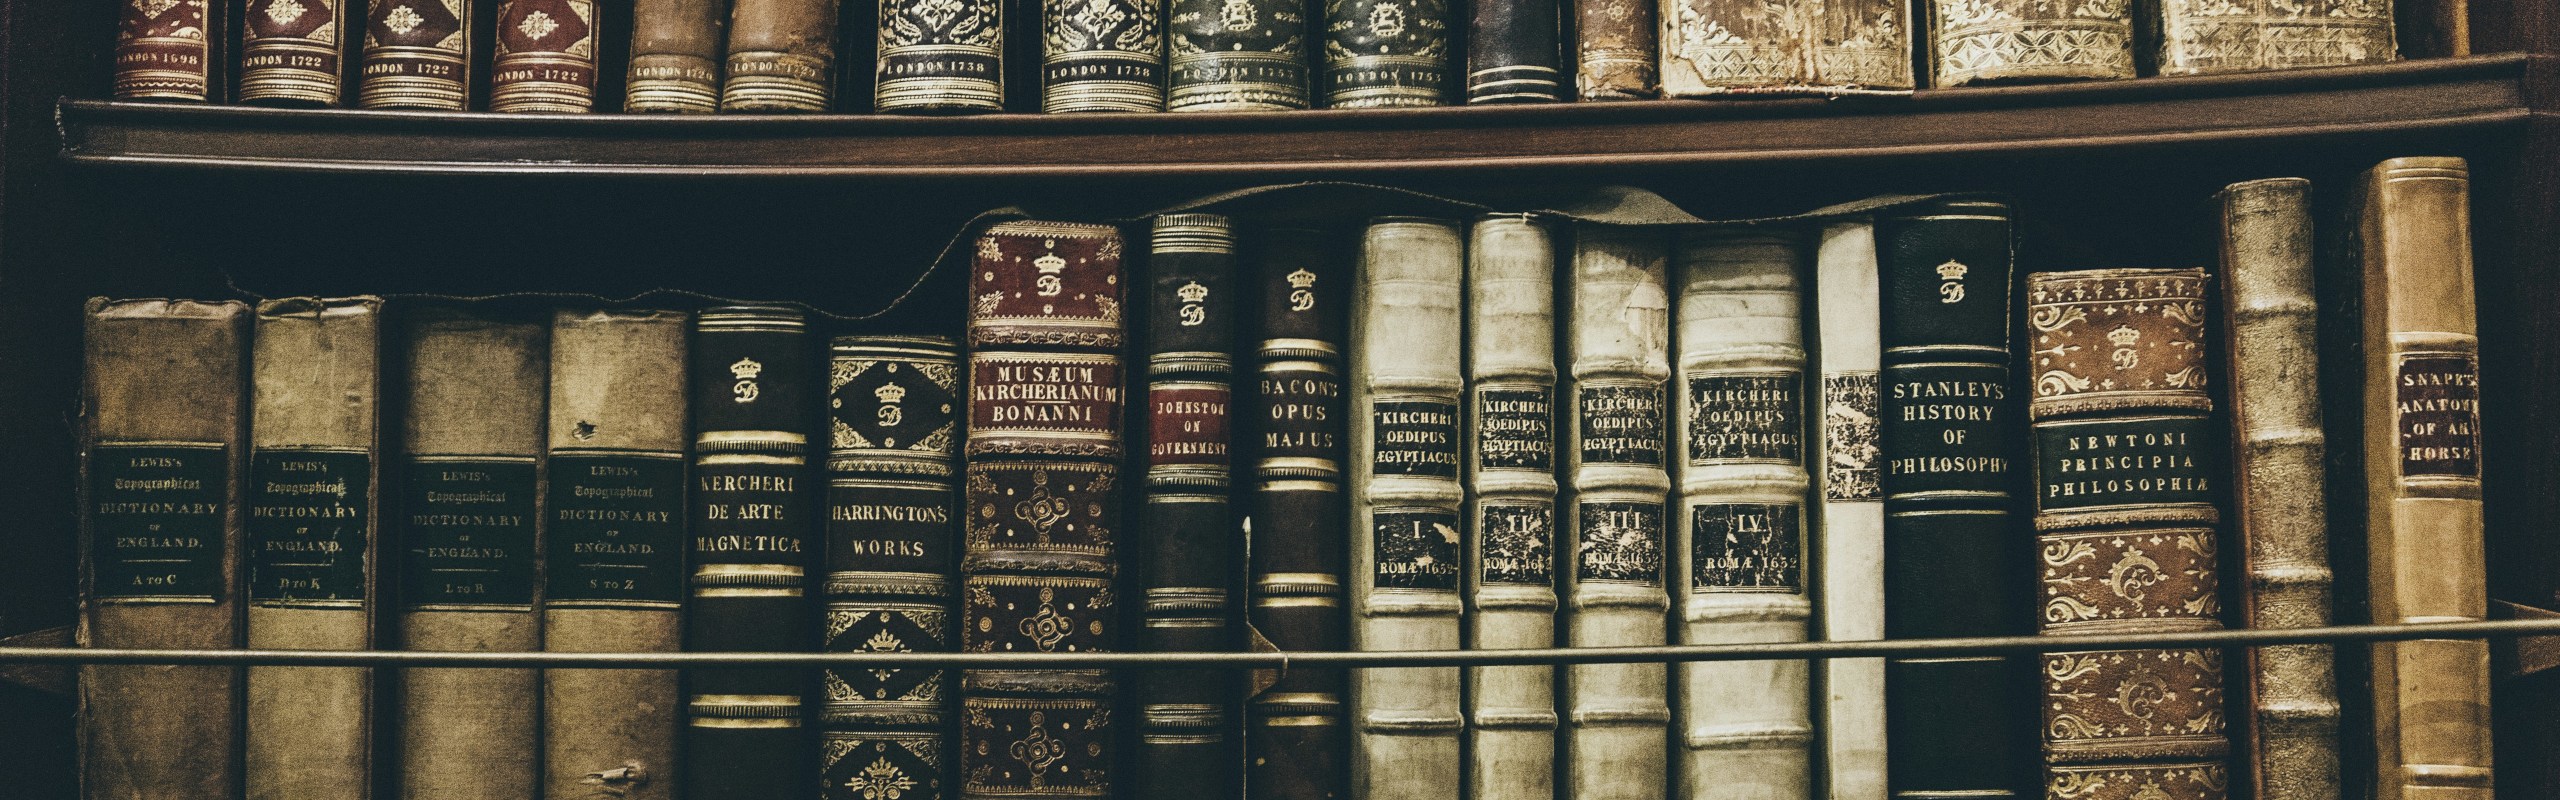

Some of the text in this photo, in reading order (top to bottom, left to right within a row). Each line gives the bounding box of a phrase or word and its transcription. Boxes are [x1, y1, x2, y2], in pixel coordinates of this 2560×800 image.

[163, 52, 198, 65] 1698
[290, 56, 322, 67] 1722
[418, 63, 449, 74] 1722
[636, 66, 680, 78] LONDON
[734, 62, 780, 72] LONDON
[886, 60, 985, 75] LONDON 1738
[1050, 64, 1150, 80] LONDON 1738
[1183, 67, 1248, 80] LONDON
[544, 70, 578, 81] 1722
[1337, 70, 1398, 84] LONDON
[997, 366, 1094, 384] MUSÆUM
[976, 384, 1117, 402] KIRCHERIANUM
[1703, 389, 1789, 402] KIRCHERI
[1894, 381, 2004, 400] STANLEY'S
[992, 405, 1092, 422] BONANNI
[1157, 401, 1224, 416] JOHNSTON
[1272, 404, 1326, 421] OPUS
[1485, 400, 1548, 414] KIRCHERI
[1903, 404, 1994, 421] HISTORY
[1382, 411, 1451, 426] KIRCHERI
[1592, 417, 1654, 429] OEDIPUS
[1710, 410, 1784, 423] OEDIPUS
[1184, 420, 1201, 433] ON
[1492, 418, 1546, 431] OEDIPUS
[2412, 422, 2436, 436] OF
[1266, 432, 1333, 448] MAJUS
[1386, 430, 1446, 444] OEDIPUS
[1943, 429, 1966, 444] OF
[2069, 432, 2186, 451] NEWTONI
[1151, 441, 1226, 456] GOVERNMENT
[1891, 456, 2008, 475] PHILOSOPHY
[2060, 455, 2193, 472] PRINCIPIA
[100, 502, 218, 514] DICTIONARY
[254, 506, 356, 518] DICTIONARY
[708, 503, 784, 520] DE ARTE
[413, 515, 522, 526] DICTIONARY
[560, 509, 669, 523] DICTIONARY
[1609, 510, 1641, 530] III
[1412, 520, 1421, 539] I
[853, 539, 924, 557] WORKS
[1762, 557, 1798, 569] 1652
[132, 574, 142, 585] A
[166, 574, 176, 585] C
[590, 579, 597, 589] S
[624, 580, 635, 590] Z
[446, 583, 454, 593] L
